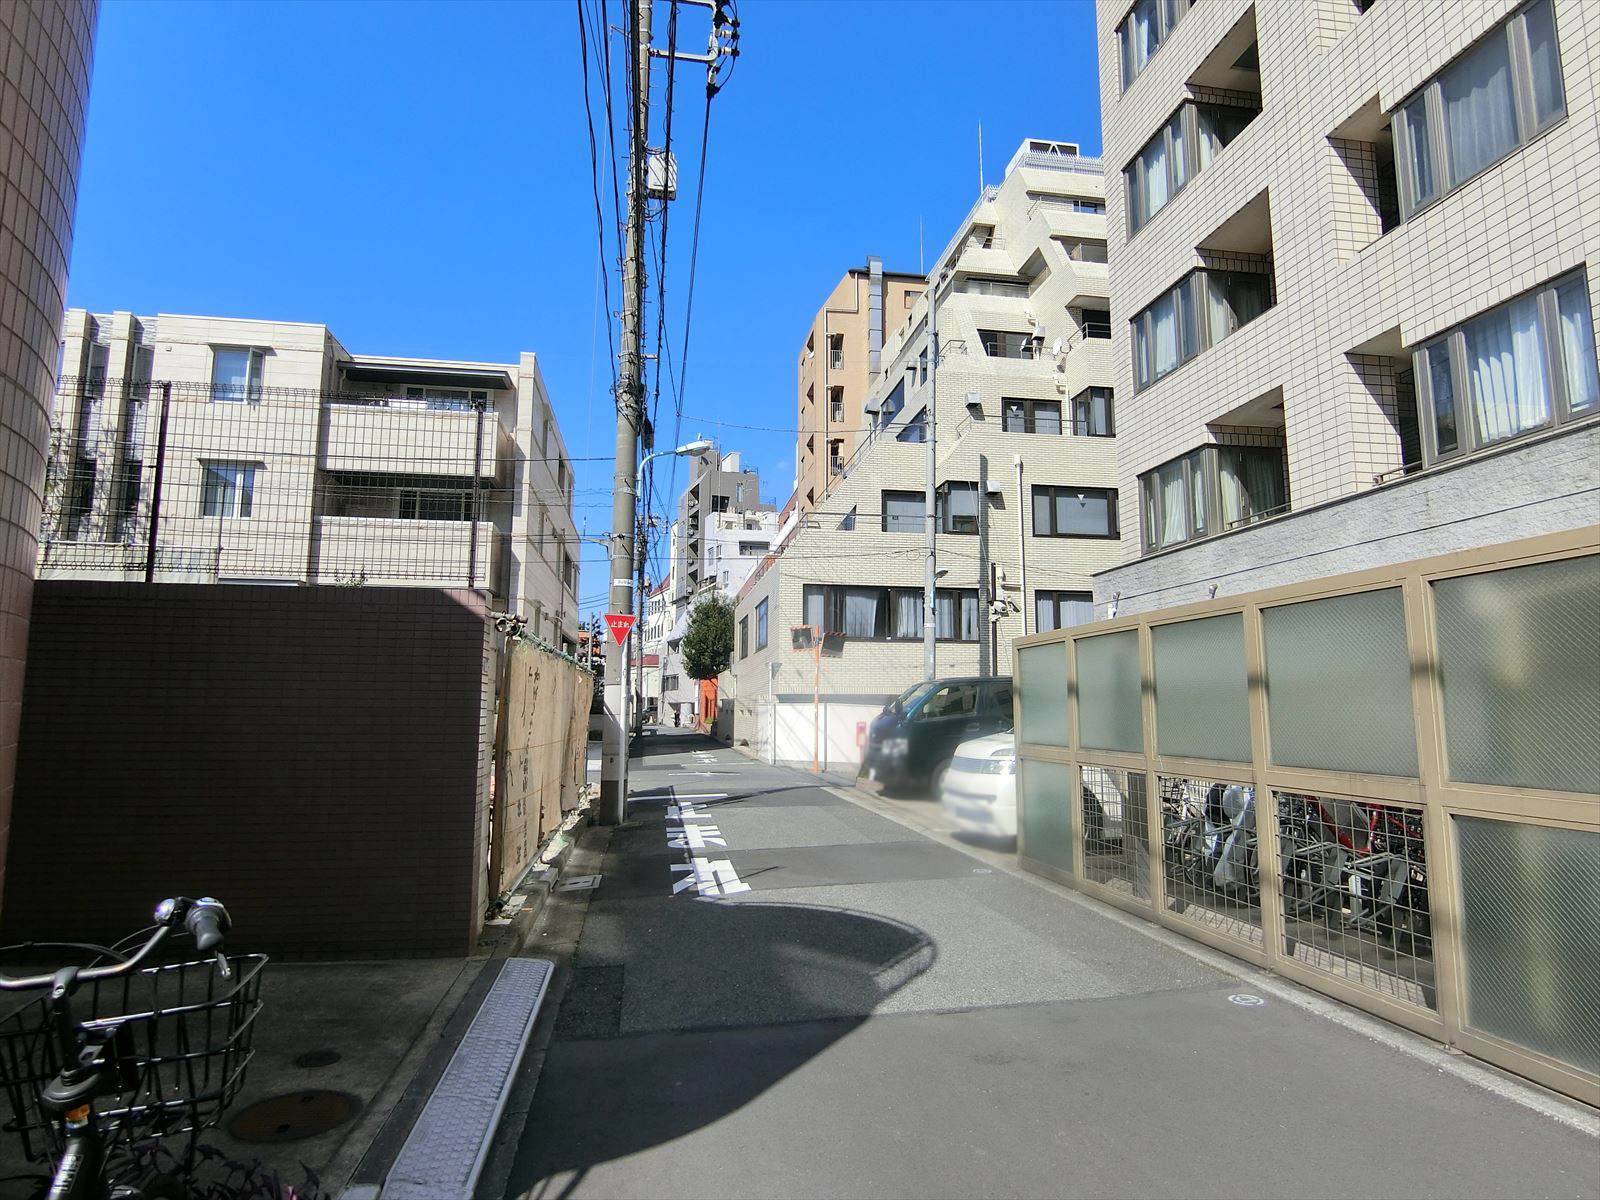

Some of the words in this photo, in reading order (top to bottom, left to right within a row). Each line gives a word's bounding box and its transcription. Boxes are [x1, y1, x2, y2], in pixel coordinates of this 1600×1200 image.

[611, 620, 630, 628] 止まれ
[664, 801, 752, 896] 止まれ
